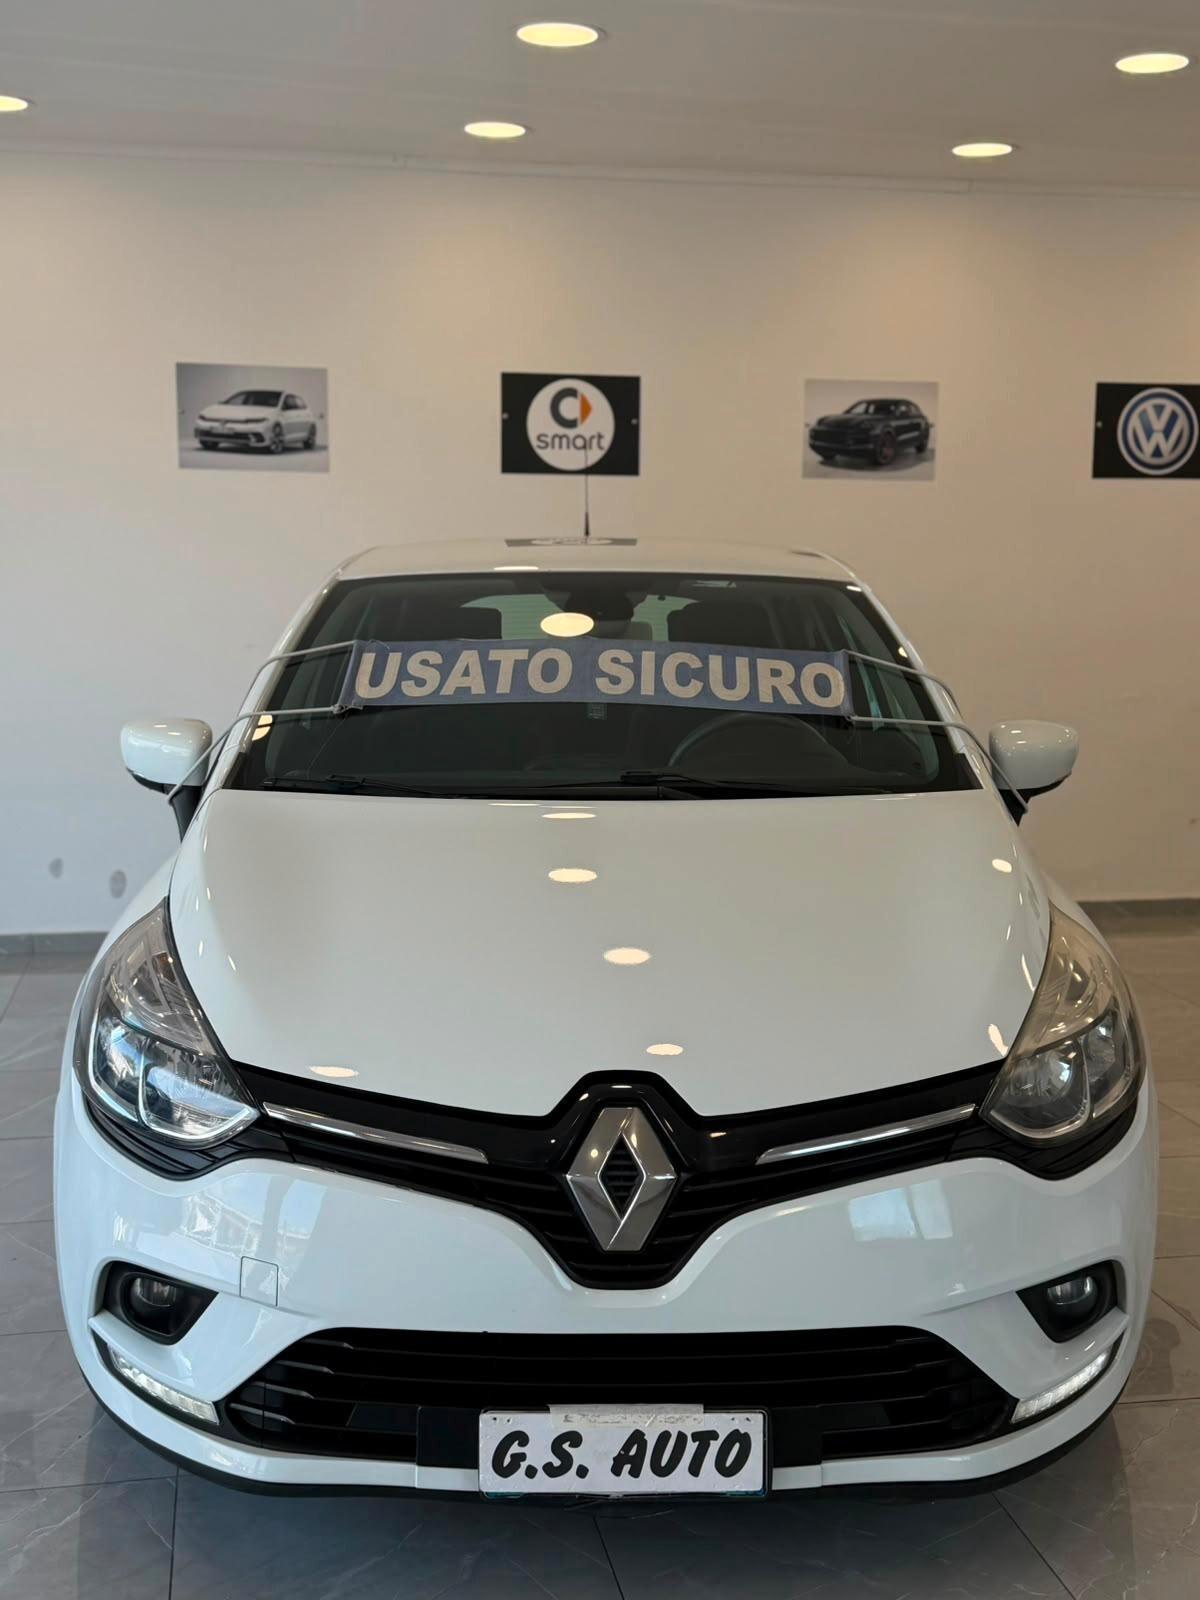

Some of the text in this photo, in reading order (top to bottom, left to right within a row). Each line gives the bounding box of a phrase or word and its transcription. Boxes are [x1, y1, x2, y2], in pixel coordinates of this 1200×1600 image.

[537, 433, 604, 450] smart
[355, 648, 845, 708] USATO SICURO
[492, 1429, 752, 1479] G.S. AUTO
